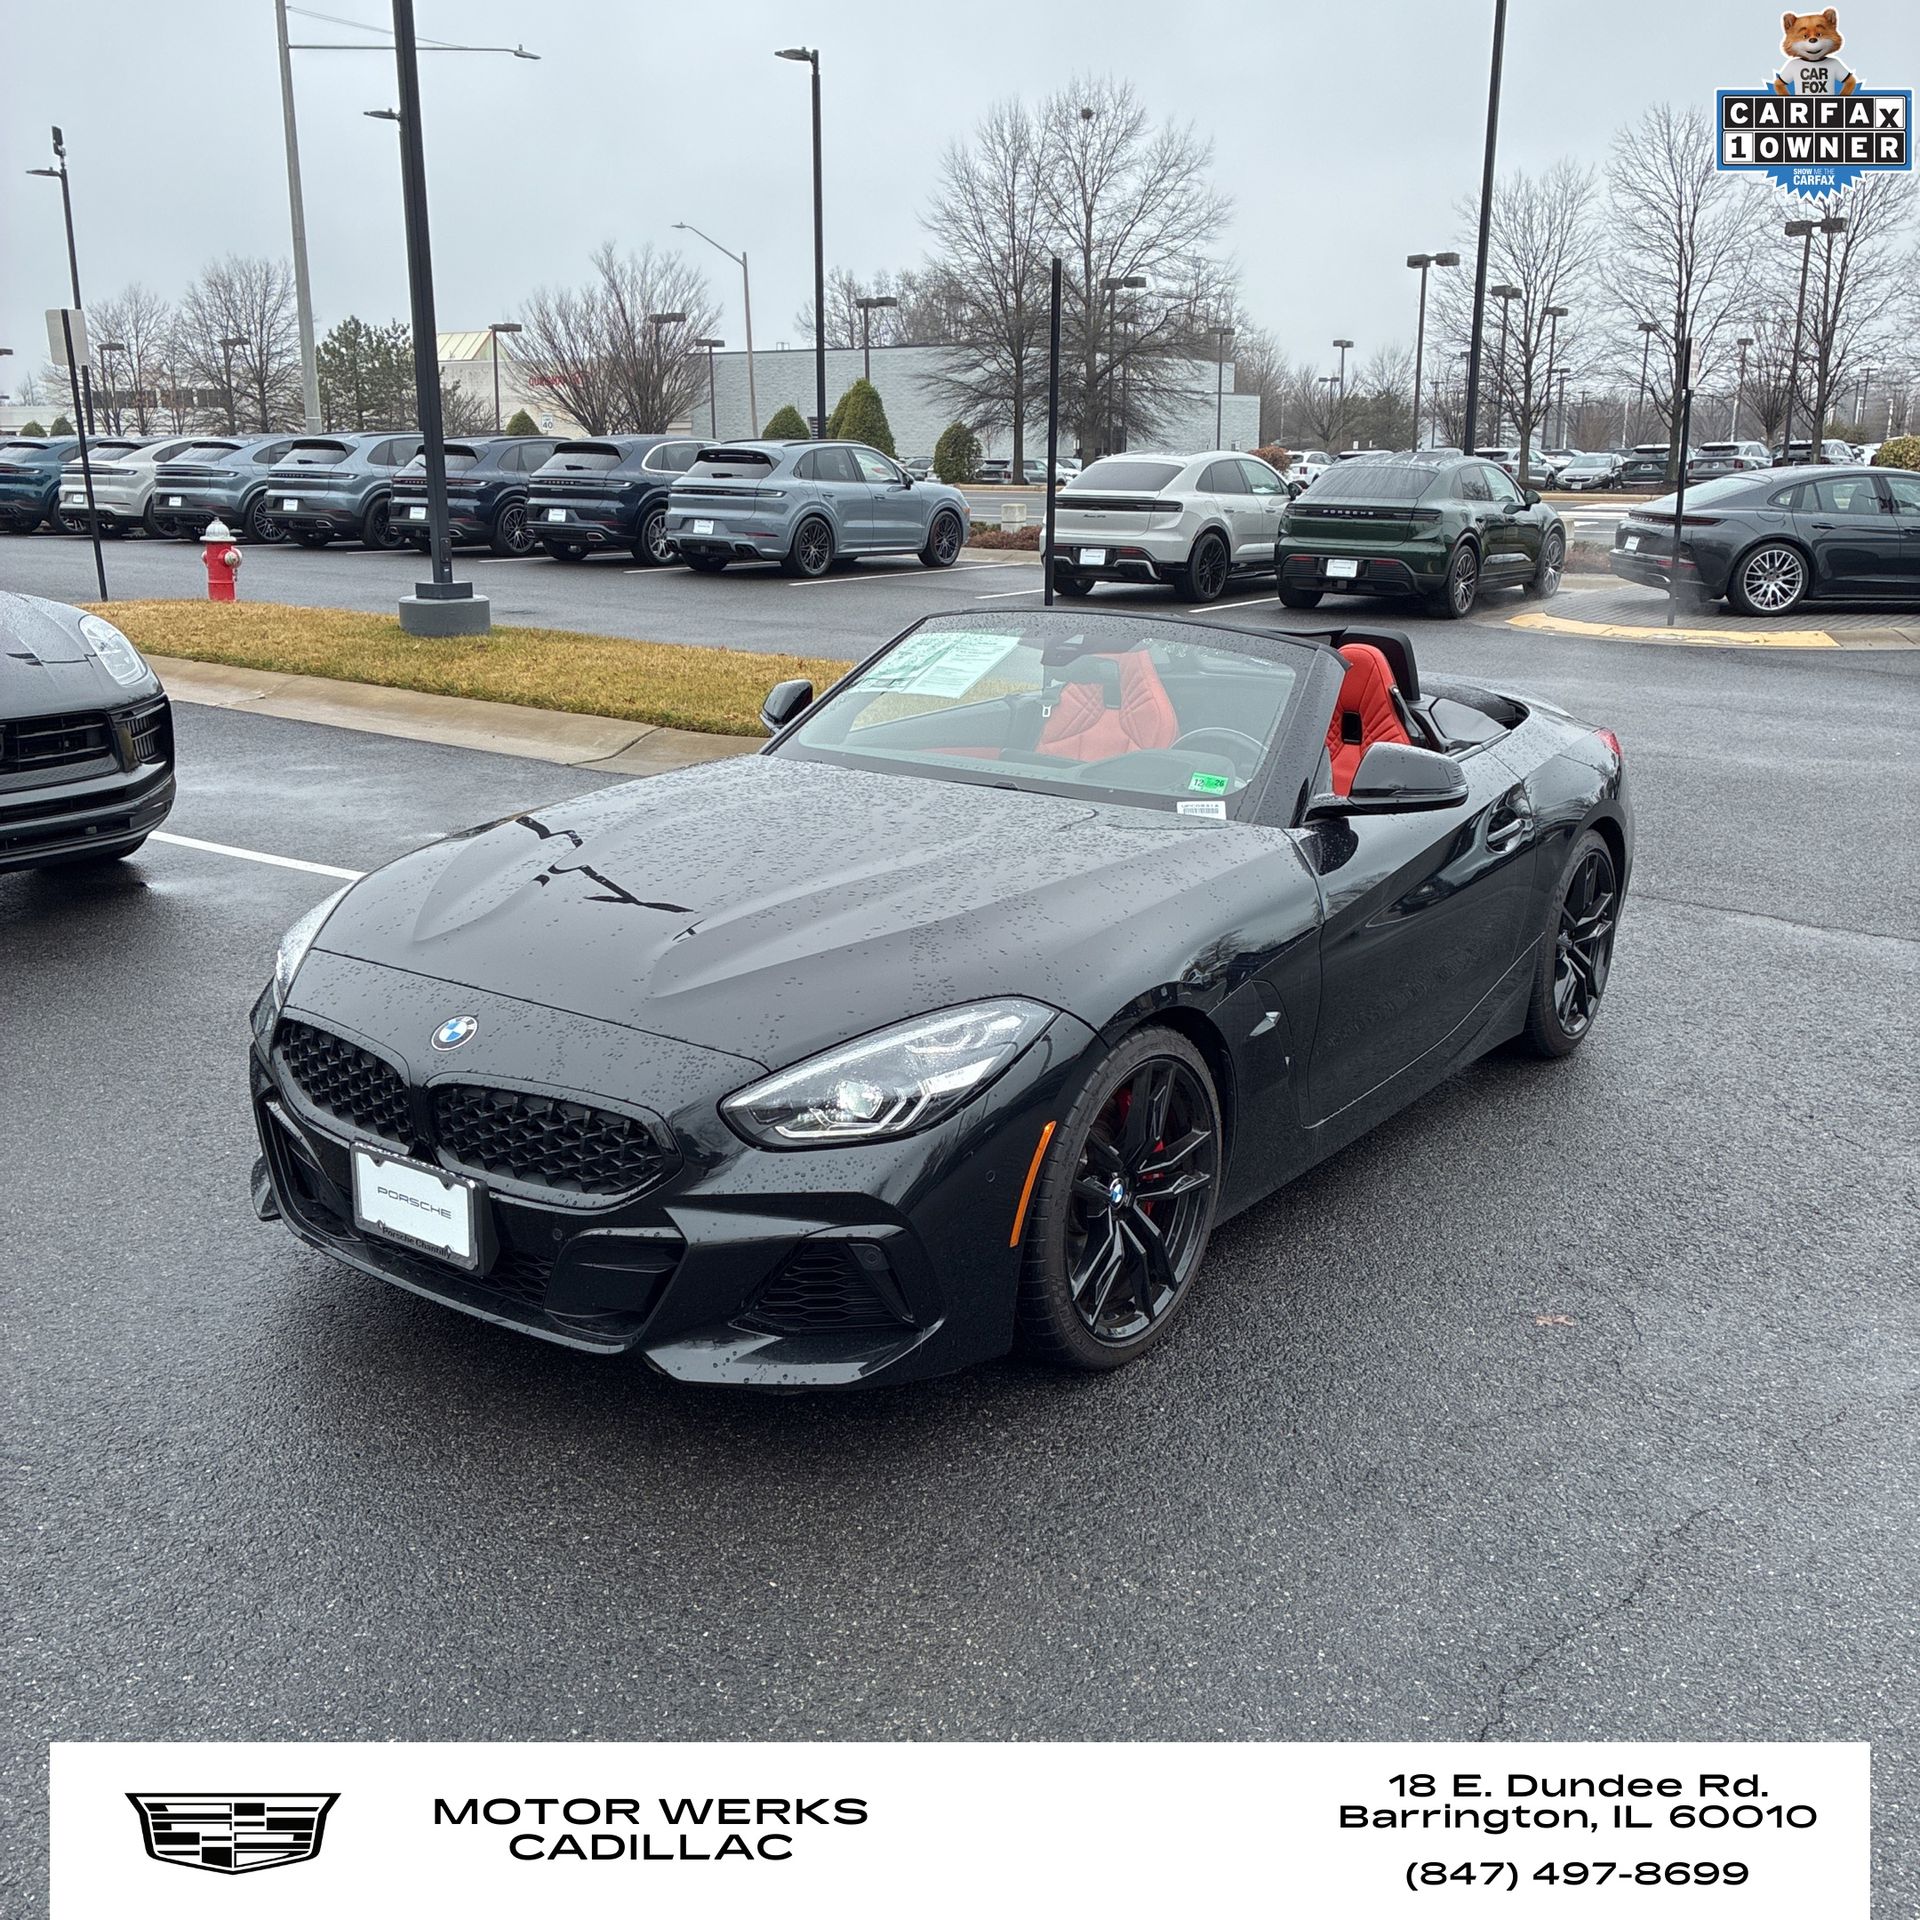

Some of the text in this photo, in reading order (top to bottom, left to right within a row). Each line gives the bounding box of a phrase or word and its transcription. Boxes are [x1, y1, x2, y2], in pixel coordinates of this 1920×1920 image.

[542, 421, 553, 429] 40
[377, 1186, 452, 1220] PORSCHE
[382, 1227, 451, 1259] Porsche Chantilly
